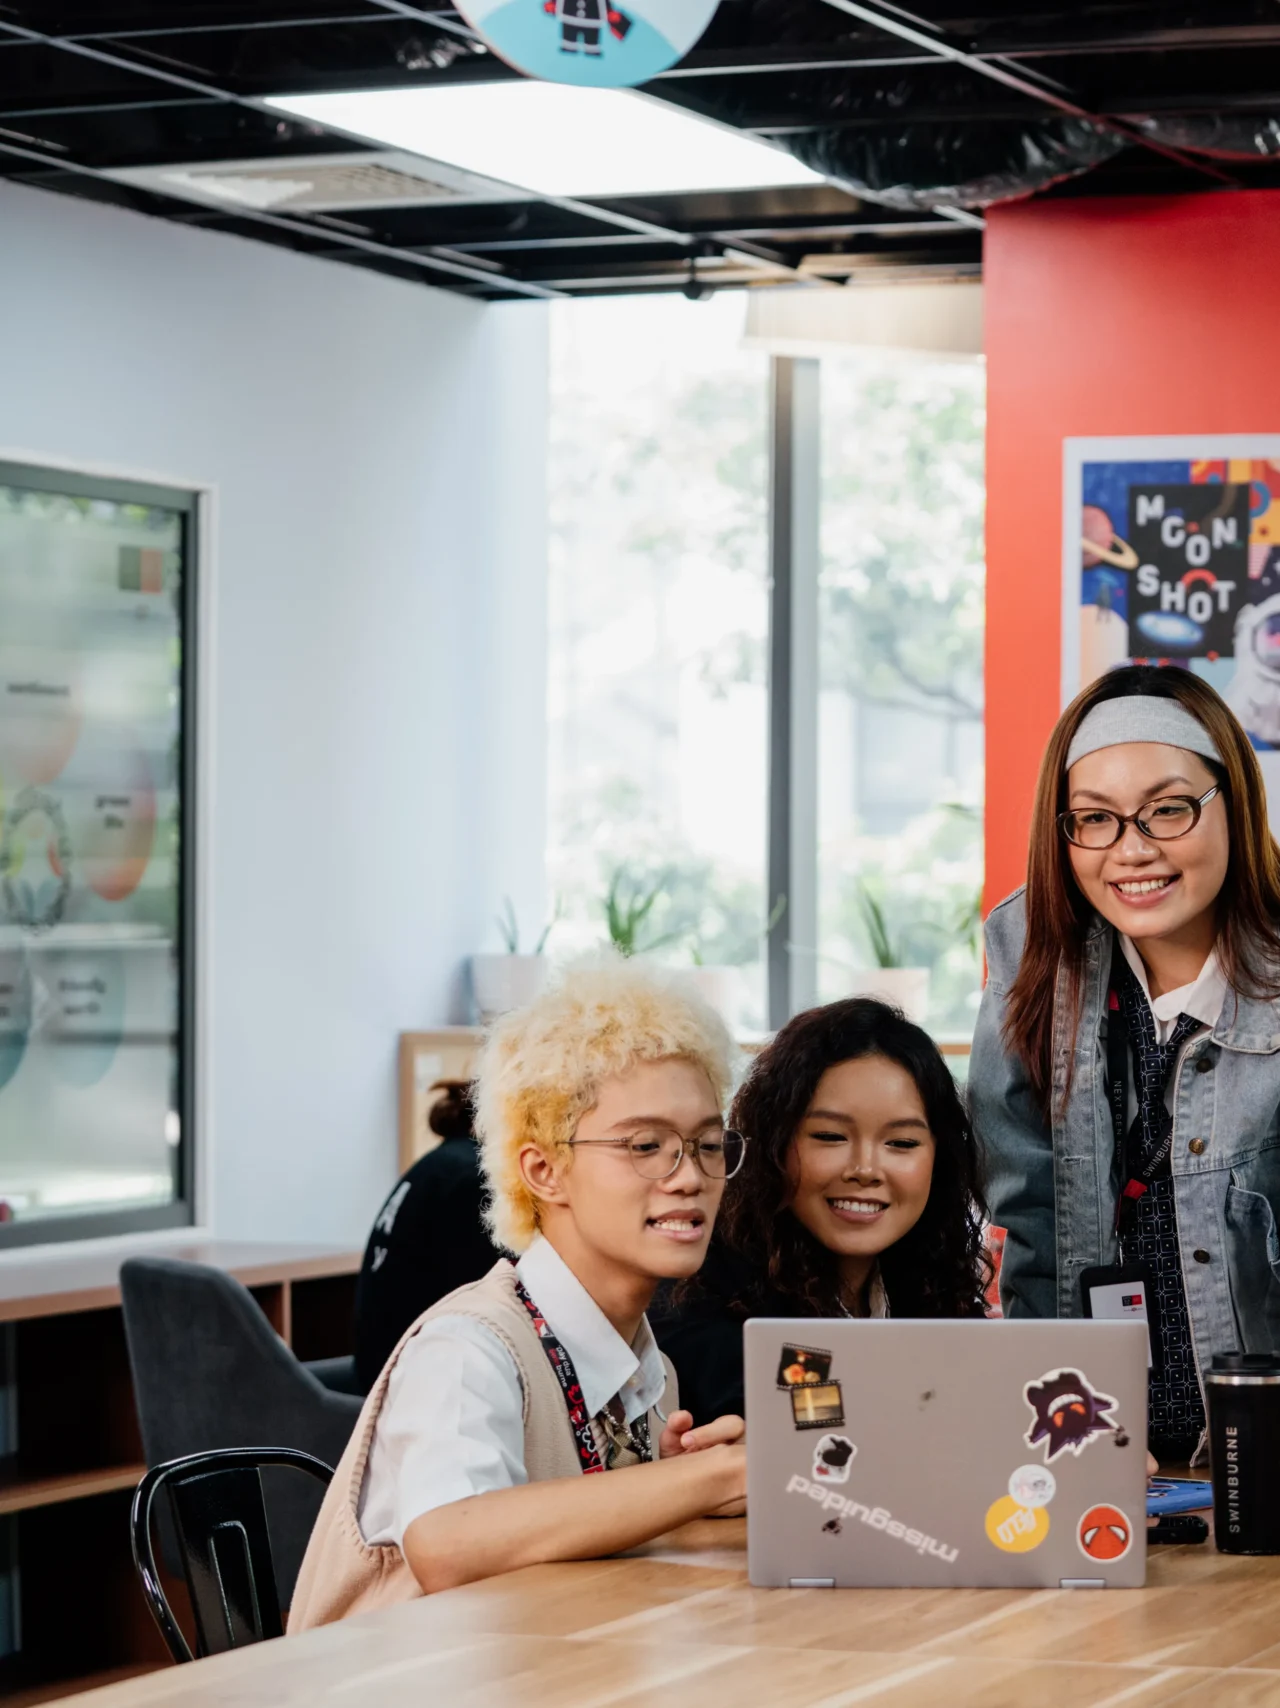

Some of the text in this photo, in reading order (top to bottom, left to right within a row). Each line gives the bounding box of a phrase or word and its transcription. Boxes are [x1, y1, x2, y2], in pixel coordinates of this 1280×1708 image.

[1136, 563, 1237, 624] SHOT
[1113, 1080, 1122, 1107] NEXT
[1115, 1113, 1123, 1135] GEN
[1142, 1127, 1173, 1178] SWINBURN
[1226, 1425, 1241, 1534] SWINBURNE
[785, 1473, 960, 1564] missguided
